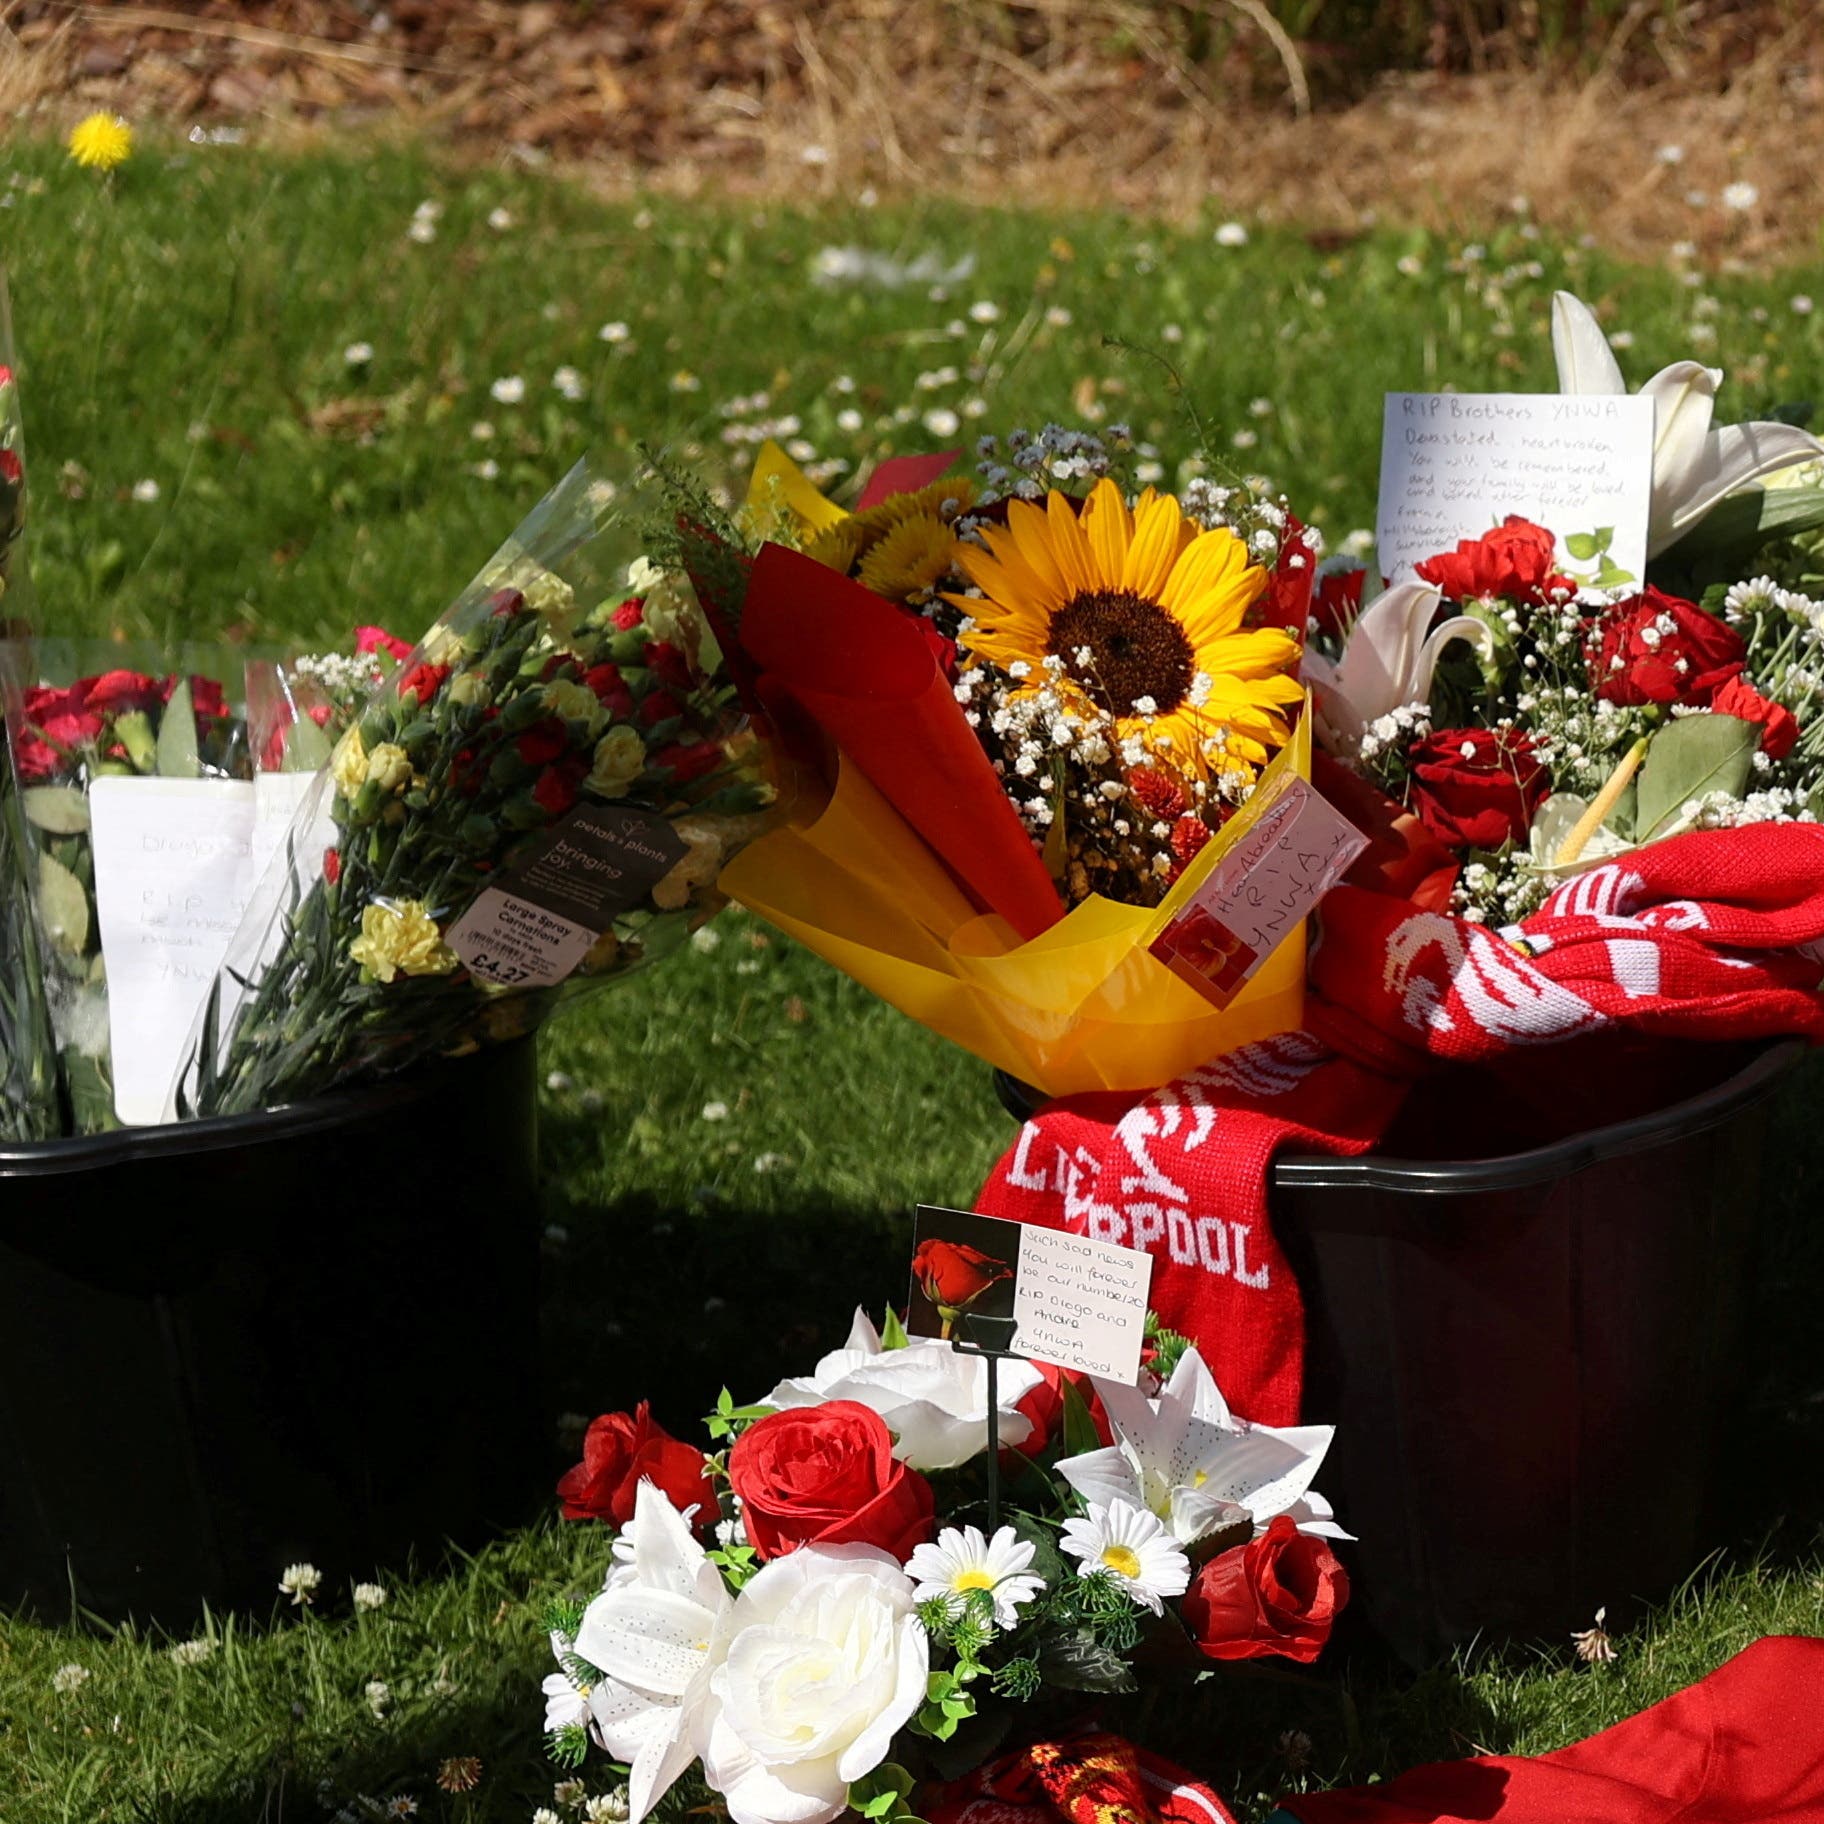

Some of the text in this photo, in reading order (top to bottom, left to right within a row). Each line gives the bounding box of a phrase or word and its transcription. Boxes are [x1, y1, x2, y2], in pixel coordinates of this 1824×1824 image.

[1402, 398, 1620, 422] RIP Brothers YNWA
[555, 839, 623, 880] bringing
[573, 819, 617, 845] petals
[623, 840, 669, 863] plants
[498, 911, 561, 945] Carnations
[503, 899, 536, 921] Large
[538, 914, 572, 938] Spray
[470, 953, 530, 983] £4.27
[1024, 1230, 1136, 1270] Such sad news
[1023, 1265, 1039, 1277] be
[1047, 1274, 1071, 1287] our
[1055, 1260, 1083, 1274] will
[1087, 1266, 1139, 1289] forever
[1018, 1286, 1127, 1328] RIP Diogo and
[1013, 1336, 1068, 1361] forever
[1073, 1353, 1111, 1374] loved
